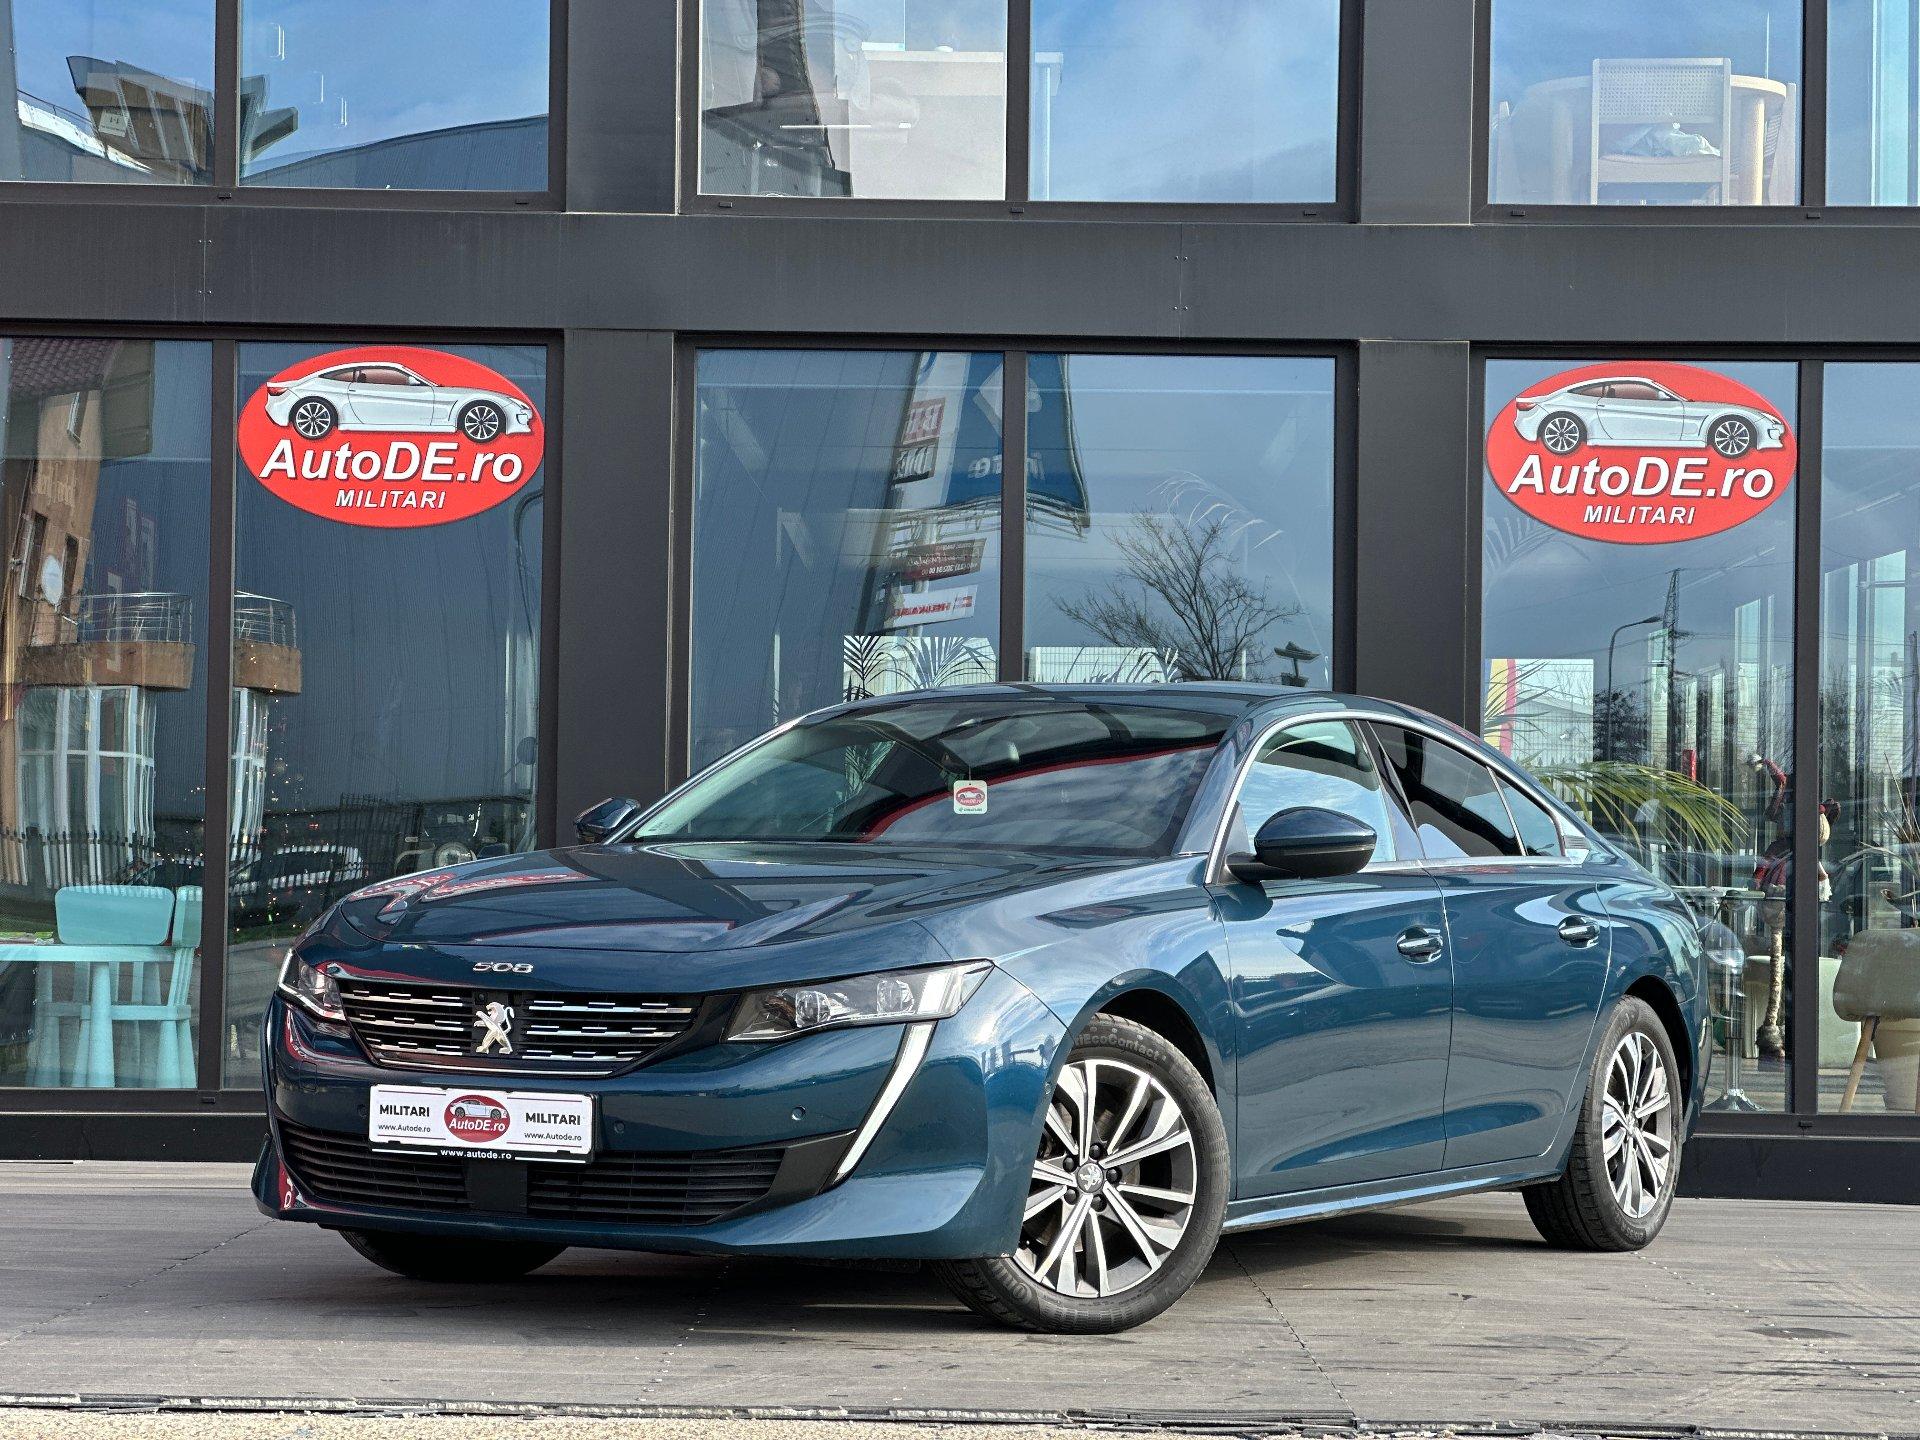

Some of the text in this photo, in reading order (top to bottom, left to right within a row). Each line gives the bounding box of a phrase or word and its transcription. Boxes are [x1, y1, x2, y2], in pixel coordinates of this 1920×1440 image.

[258, 439, 523, 484] AutoDE.ro
[1507, 454, 1775, 499] AutoDE.ro
[335, 489, 446, 509] MILITARI
[1583, 505, 1696, 525] MILITARI
[473, 962, 534, 973] 508
[379, 1104, 430, 1118] MILITARI
[448, 1117, 506, 1133] AutoDE.ro
[525, 1112, 581, 1126] MILITARI
[377, 1123, 431, 1133] www.Autode.ro
[523, 1131, 582, 1142] www.Autode.ro
[440, 1148, 512, 1160] www.autode.ro
